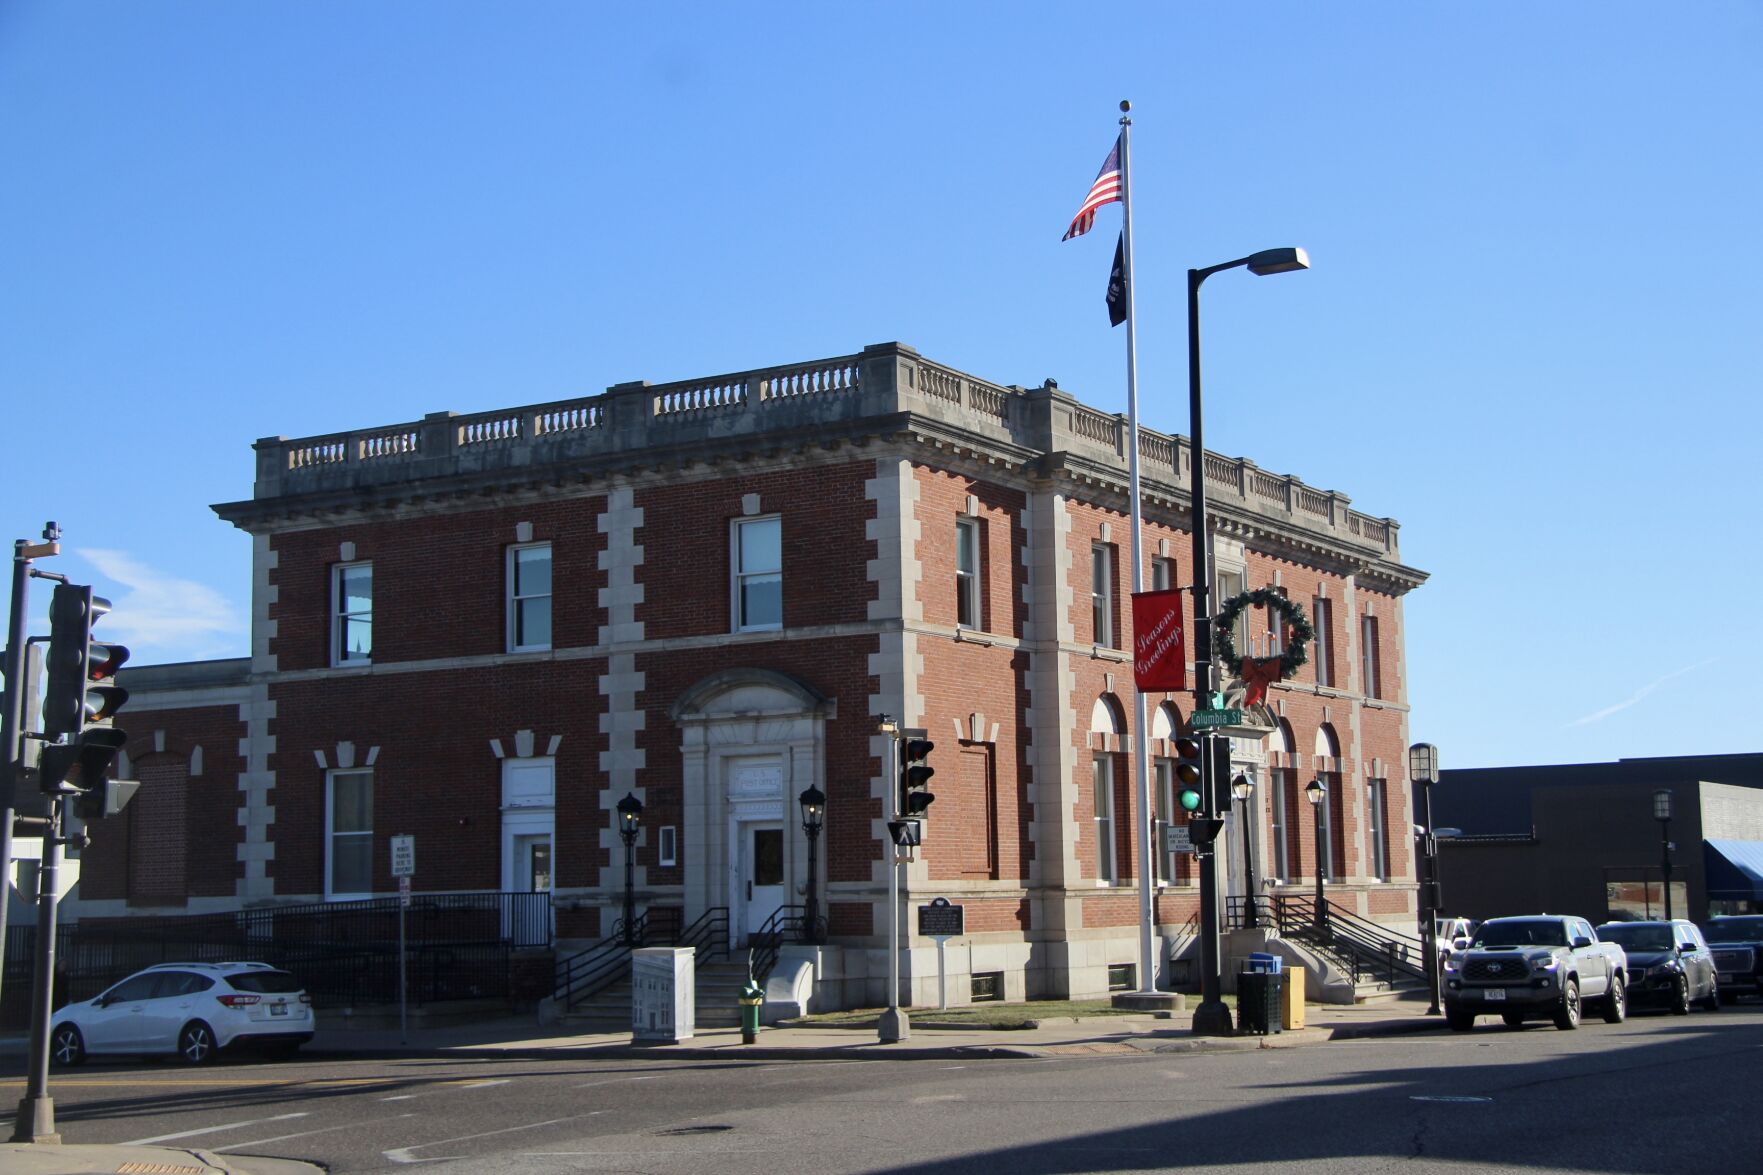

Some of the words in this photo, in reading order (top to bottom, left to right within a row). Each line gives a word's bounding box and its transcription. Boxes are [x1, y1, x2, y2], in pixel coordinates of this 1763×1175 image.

[1135, 625, 1182, 674] Greetings
[1138, 608, 1175, 653] Seasons
[1191, 711, 1227, 725] Columbia
[1231, 711, 1241, 723] St
